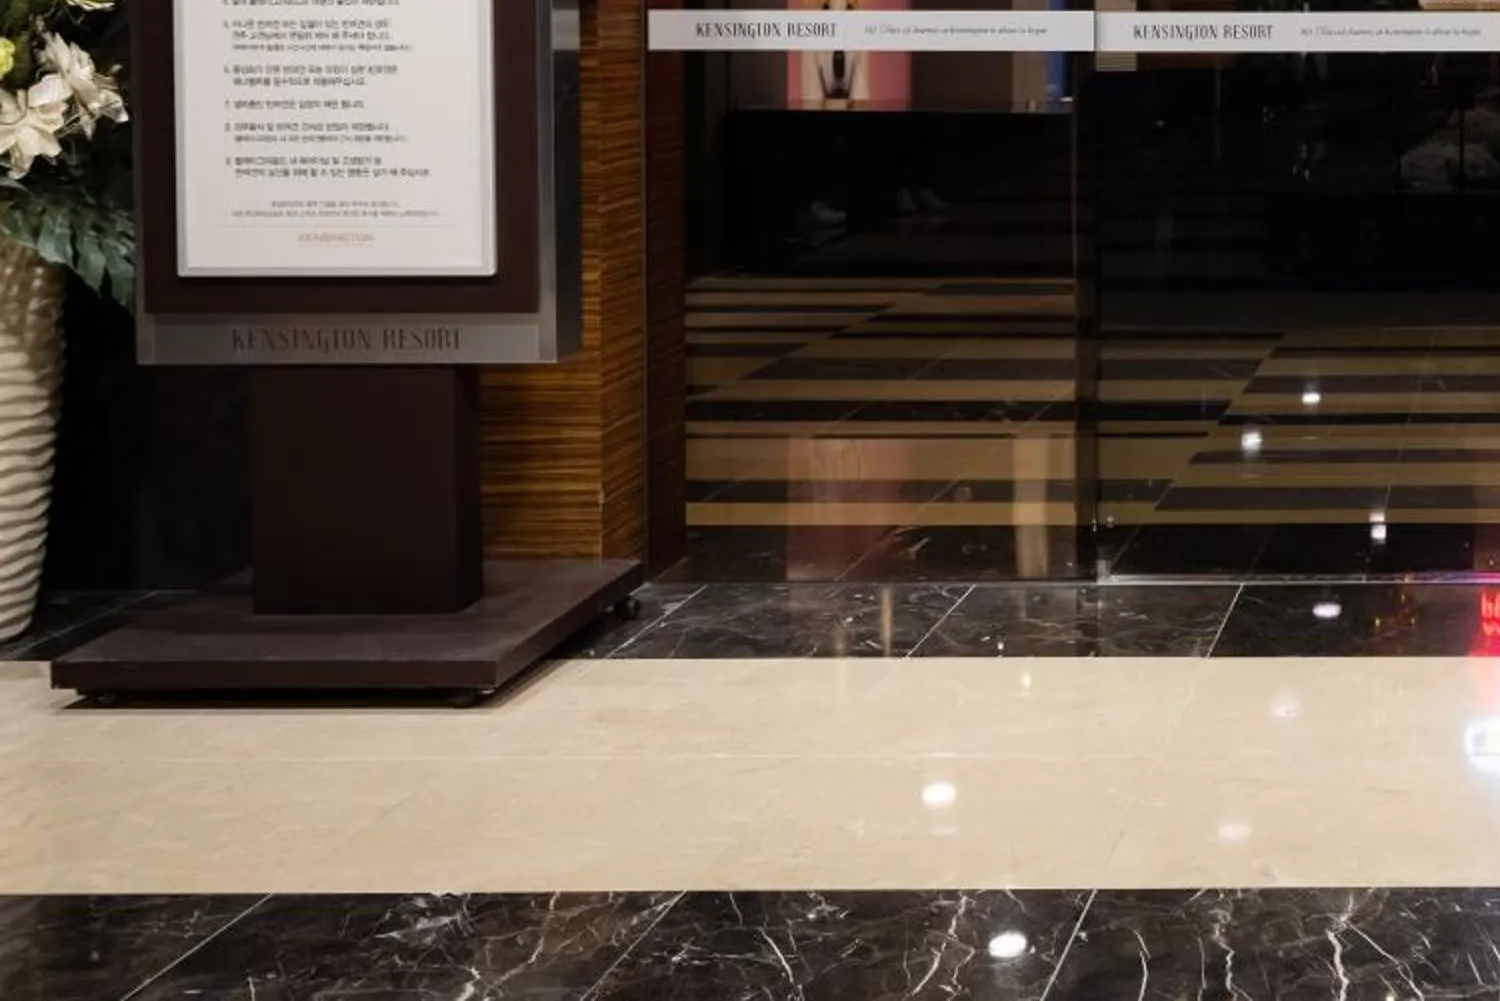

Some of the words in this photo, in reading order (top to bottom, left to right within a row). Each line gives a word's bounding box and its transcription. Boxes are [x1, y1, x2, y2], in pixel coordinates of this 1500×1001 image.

[695, 22, 782, 39] KENSINGTON
[787, 22, 837, 38] RESORT
[1132, 24, 1218, 41] KENSINGTON
[1223, 24, 1273, 40] RESORT
[231, 326, 371, 353] KENSINGTON
[382, 326, 462, 351] RESORT
